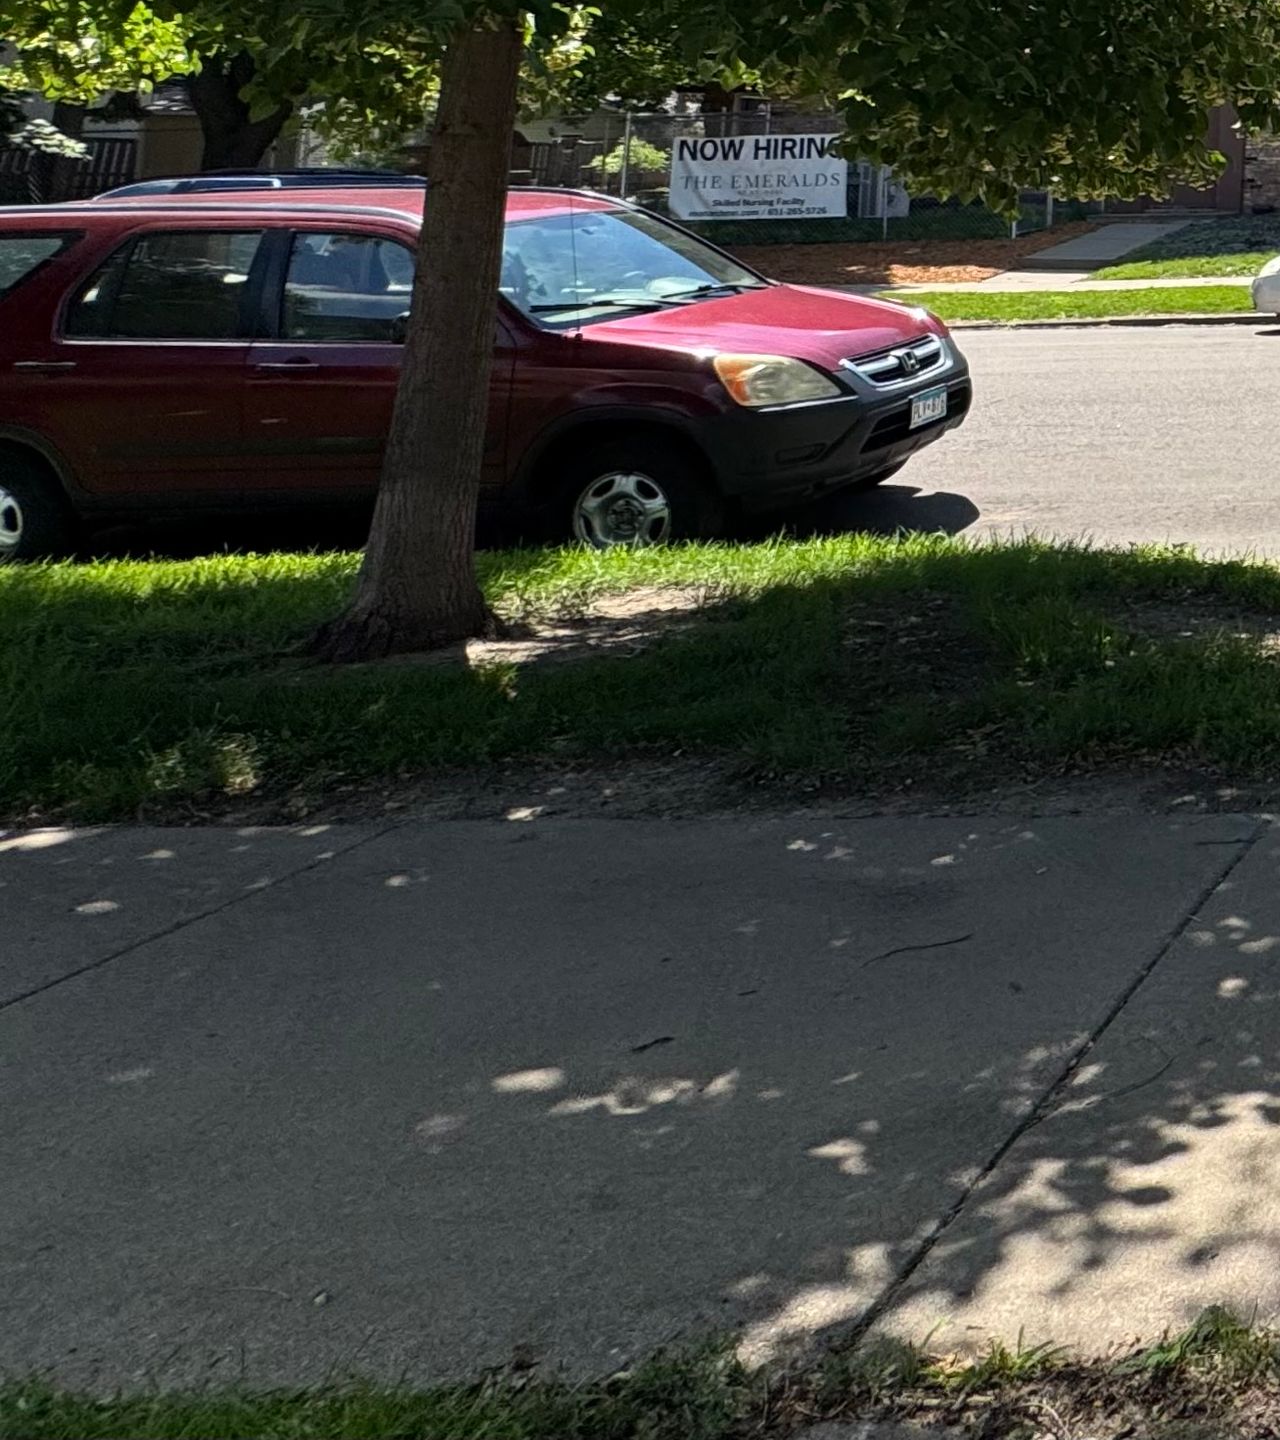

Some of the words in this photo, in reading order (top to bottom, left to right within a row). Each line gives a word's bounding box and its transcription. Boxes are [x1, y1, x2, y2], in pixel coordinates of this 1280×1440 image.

[678, 138, 745, 161] NOW
[680, 175, 722, 190] THE
[731, 172, 841, 189] EMERALDS
[711, 199, 741, 207] Skilled
[742, 198, 775, 207] Nursing
[776, 197, 806, 207] Facility
